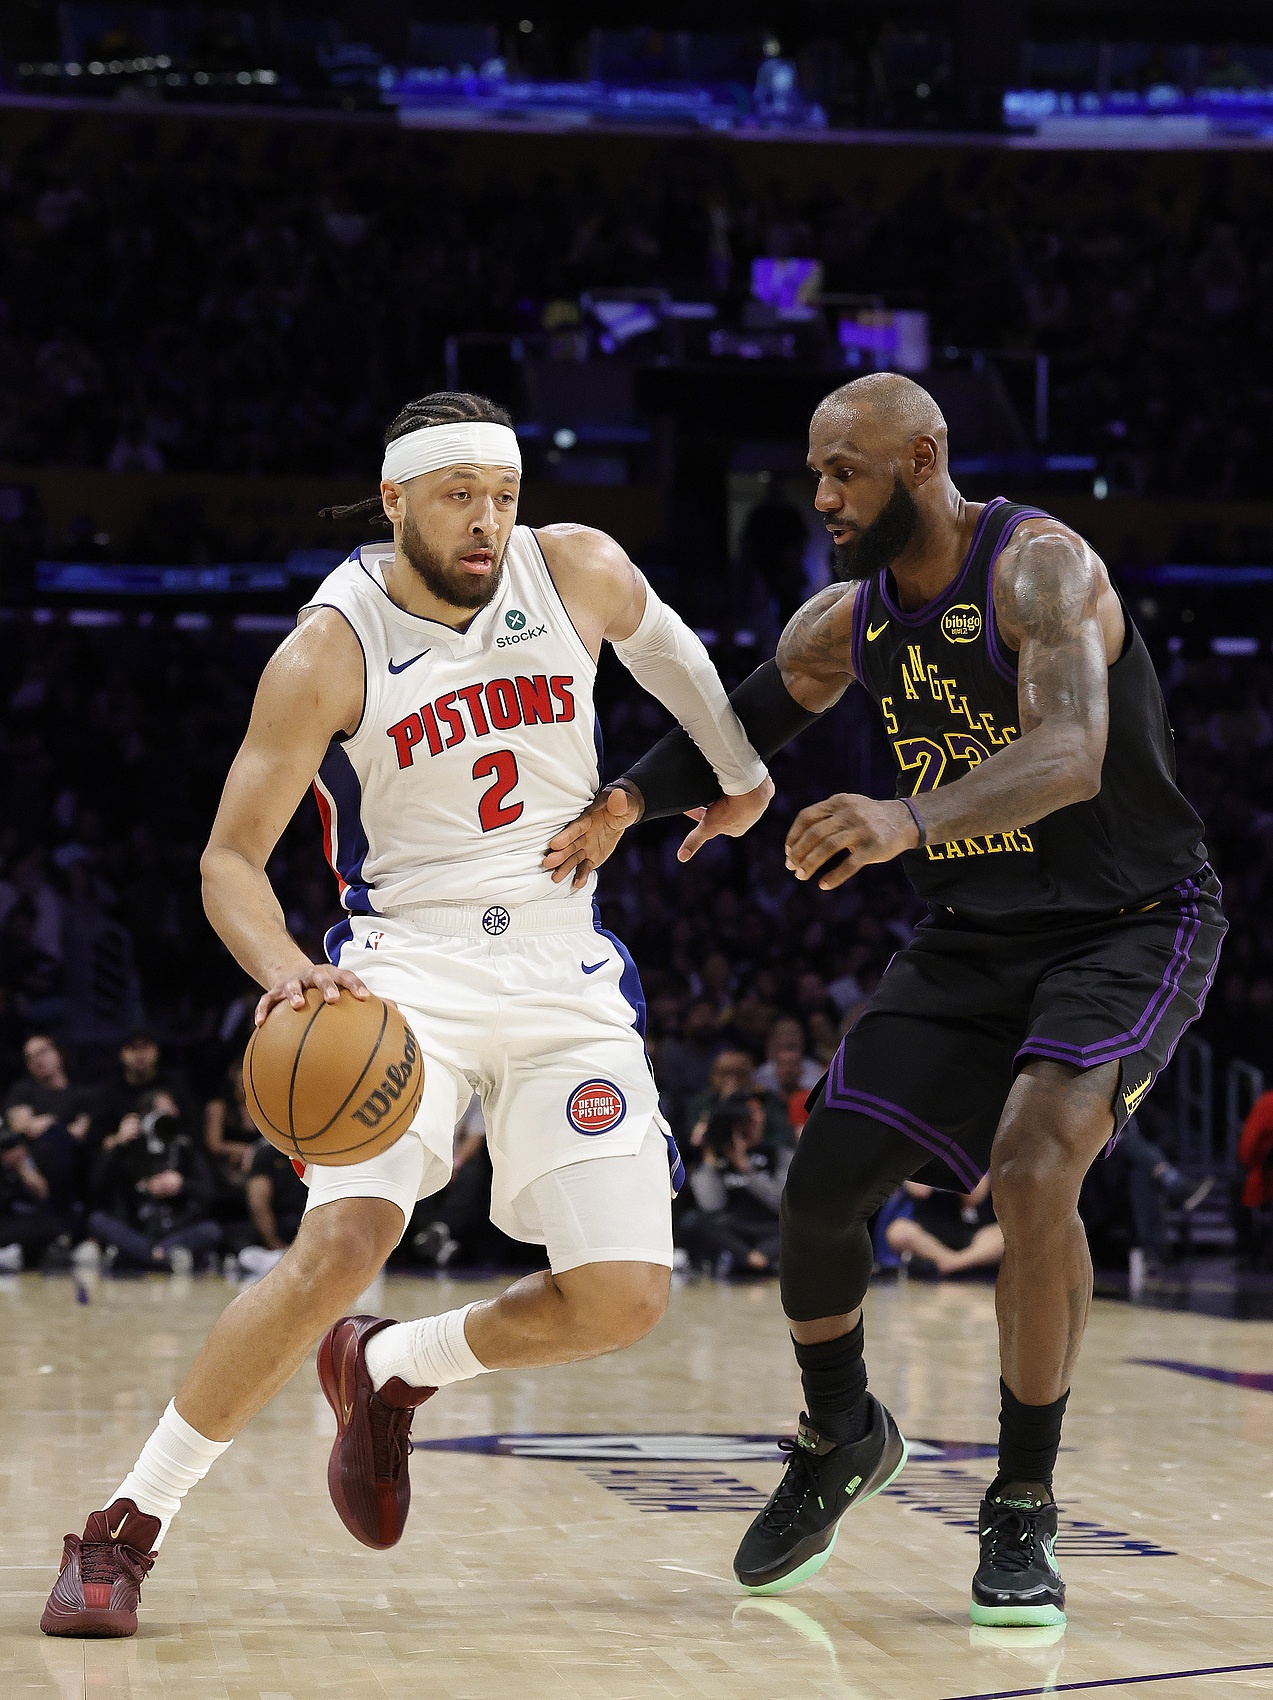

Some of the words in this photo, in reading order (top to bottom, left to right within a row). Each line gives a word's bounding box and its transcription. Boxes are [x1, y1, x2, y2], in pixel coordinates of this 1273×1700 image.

[945, 614, 980, 632] bibigo
[496, 624, 548, 648] StockX
[387, 674, 575, 770] PISTONS
[472, 749, 525, 833] 2
[350, 1025, 417, 1129] Wilson
[577, 1097, 615, 1109] DETROIT
[577, 1105, 615, 1118] PISTONS
